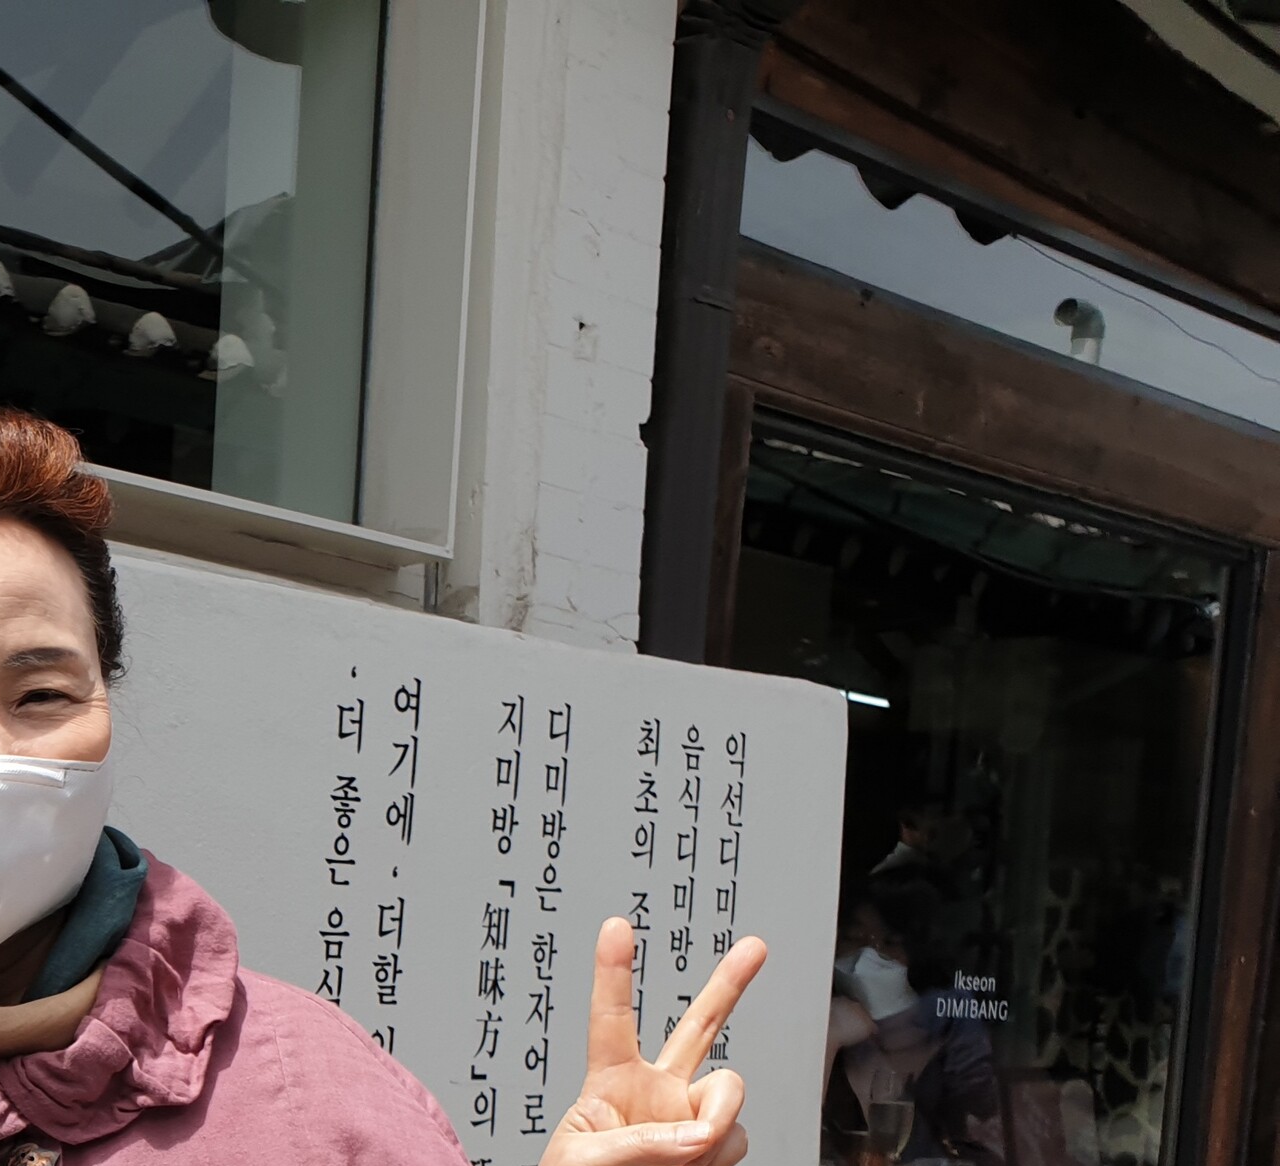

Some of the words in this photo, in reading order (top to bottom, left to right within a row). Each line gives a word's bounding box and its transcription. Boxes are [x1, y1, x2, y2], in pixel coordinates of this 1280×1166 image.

[324, 775, 362, 886] 좋은
[385, 677, 422, 846] 여기에
[491, 694, 525, 855] 지미방
[534, 702, 572, 912] 디미방은
[630, 717, 660, 869] 최초의
[669, 724, 705, 973] 음식디미방
[520, 932, 558, 1135] 한자어로
[936, 998, 1009, 1021] DIMIBANG
[954, 970, 997, 992] Ikseon
